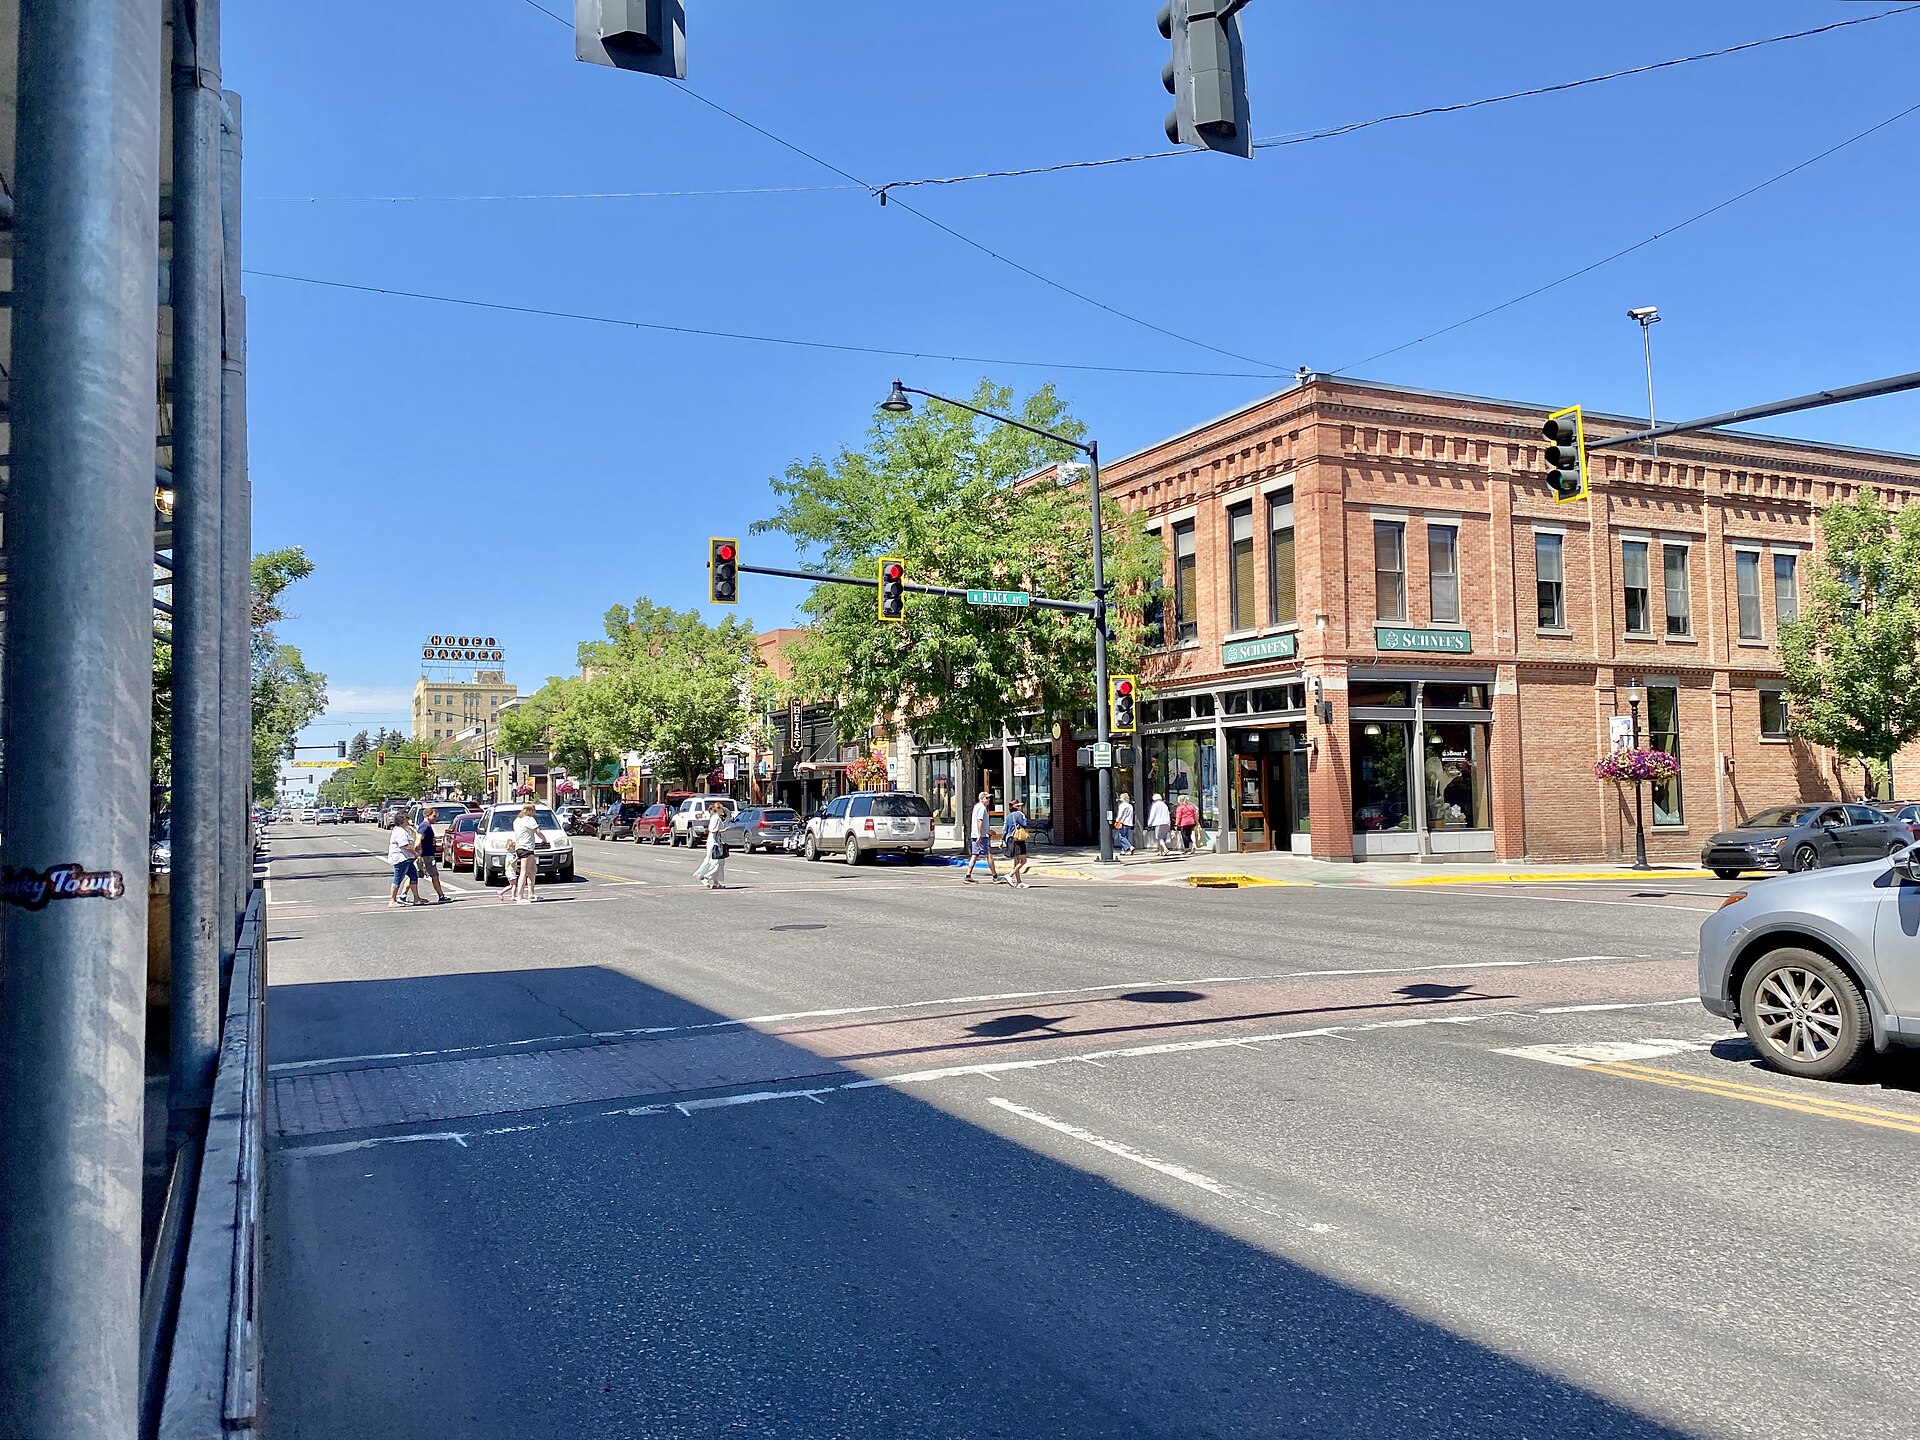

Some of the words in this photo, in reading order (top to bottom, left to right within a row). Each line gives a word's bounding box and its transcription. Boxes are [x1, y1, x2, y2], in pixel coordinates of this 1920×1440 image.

[982, 592, 1008, 604] BLACK
[1012, 596, 1023, 605] AVE
[432, 635, 495, 647] HOTEL
[1240, 638, 1289, 660] SCHNEE'S
[1402, 633, 1464, 650] SCHNEE'S
[426, 649, 502, 661] BAXTER
[793, 705, 801, 747] HEIST
[51, 869, 118, 898] Town
